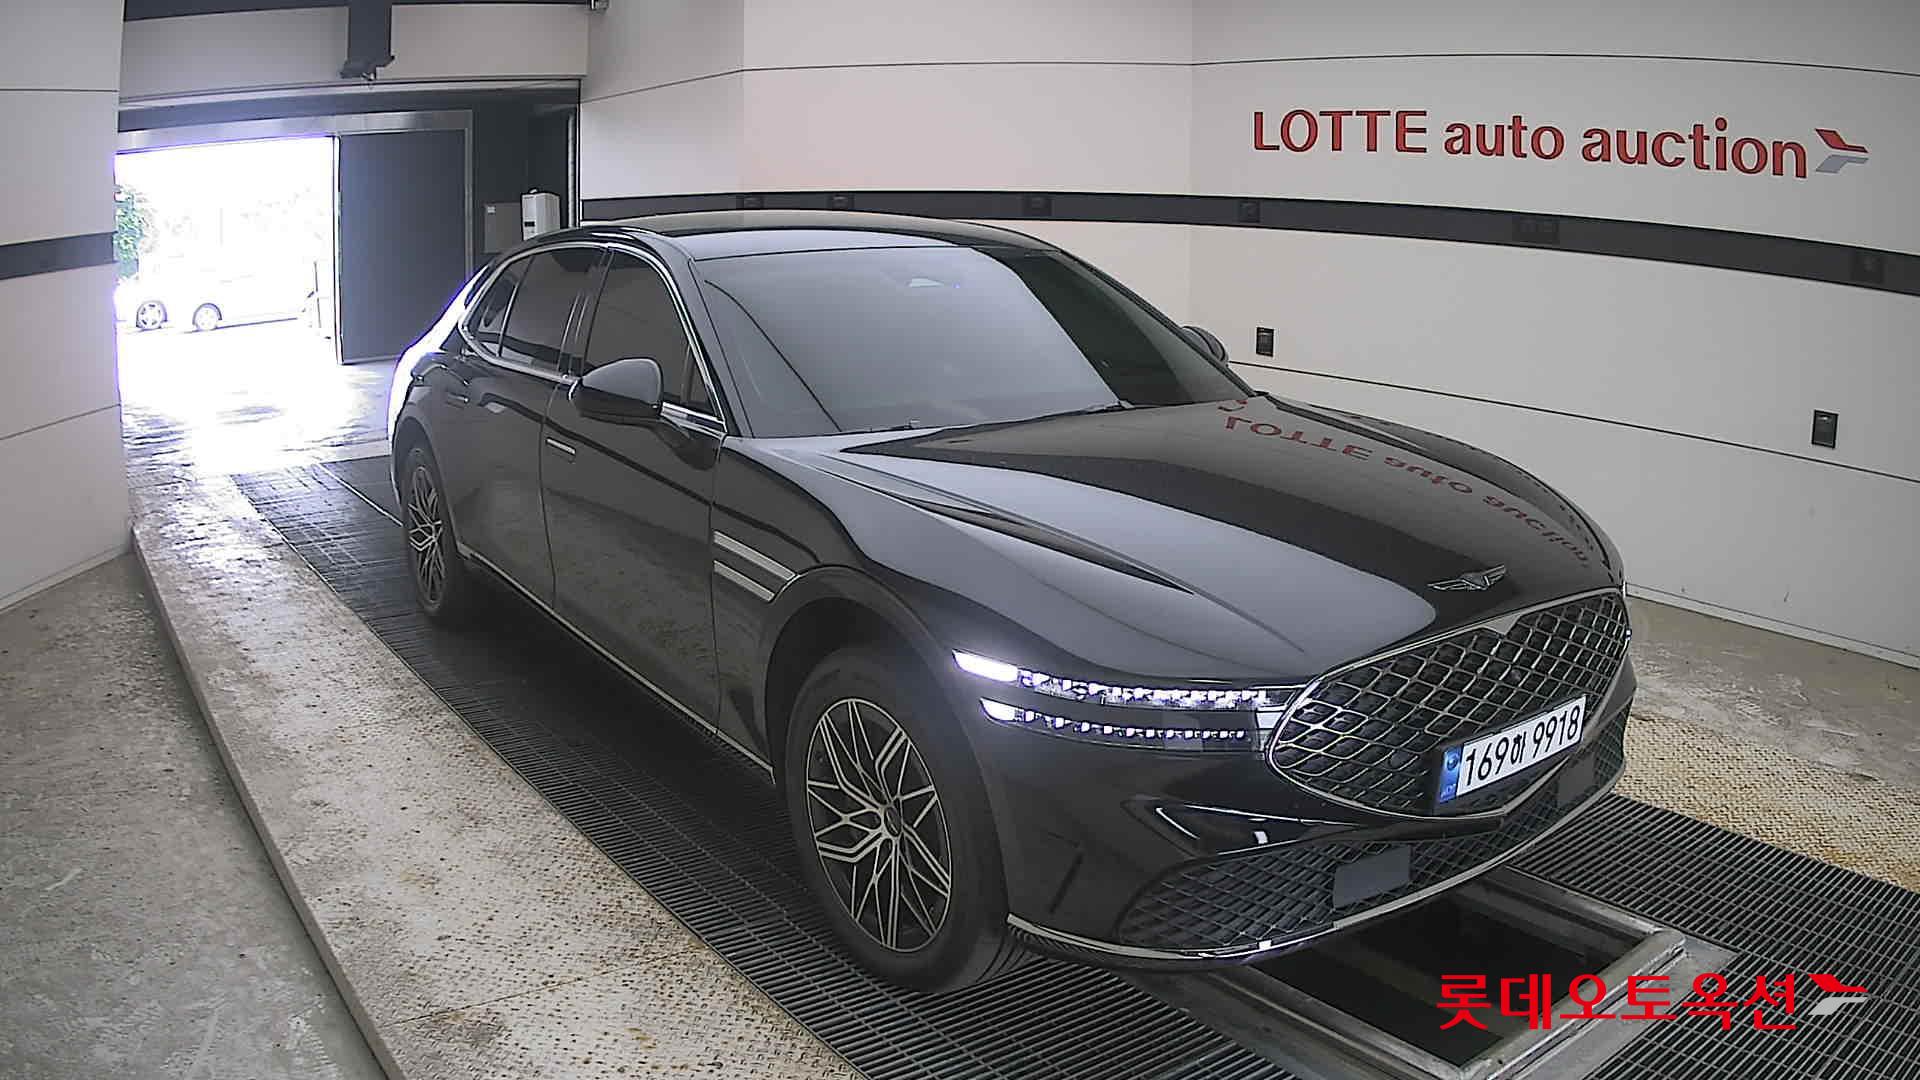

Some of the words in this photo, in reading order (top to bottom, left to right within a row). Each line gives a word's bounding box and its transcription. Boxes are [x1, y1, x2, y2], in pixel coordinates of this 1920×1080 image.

[1252, 110, 1427, 154] LOTTE
[1443, 115, 1566, 160] auto
[1581, 117, 1808, 179] auction
[1532, 704, 1581, 758] 9918
